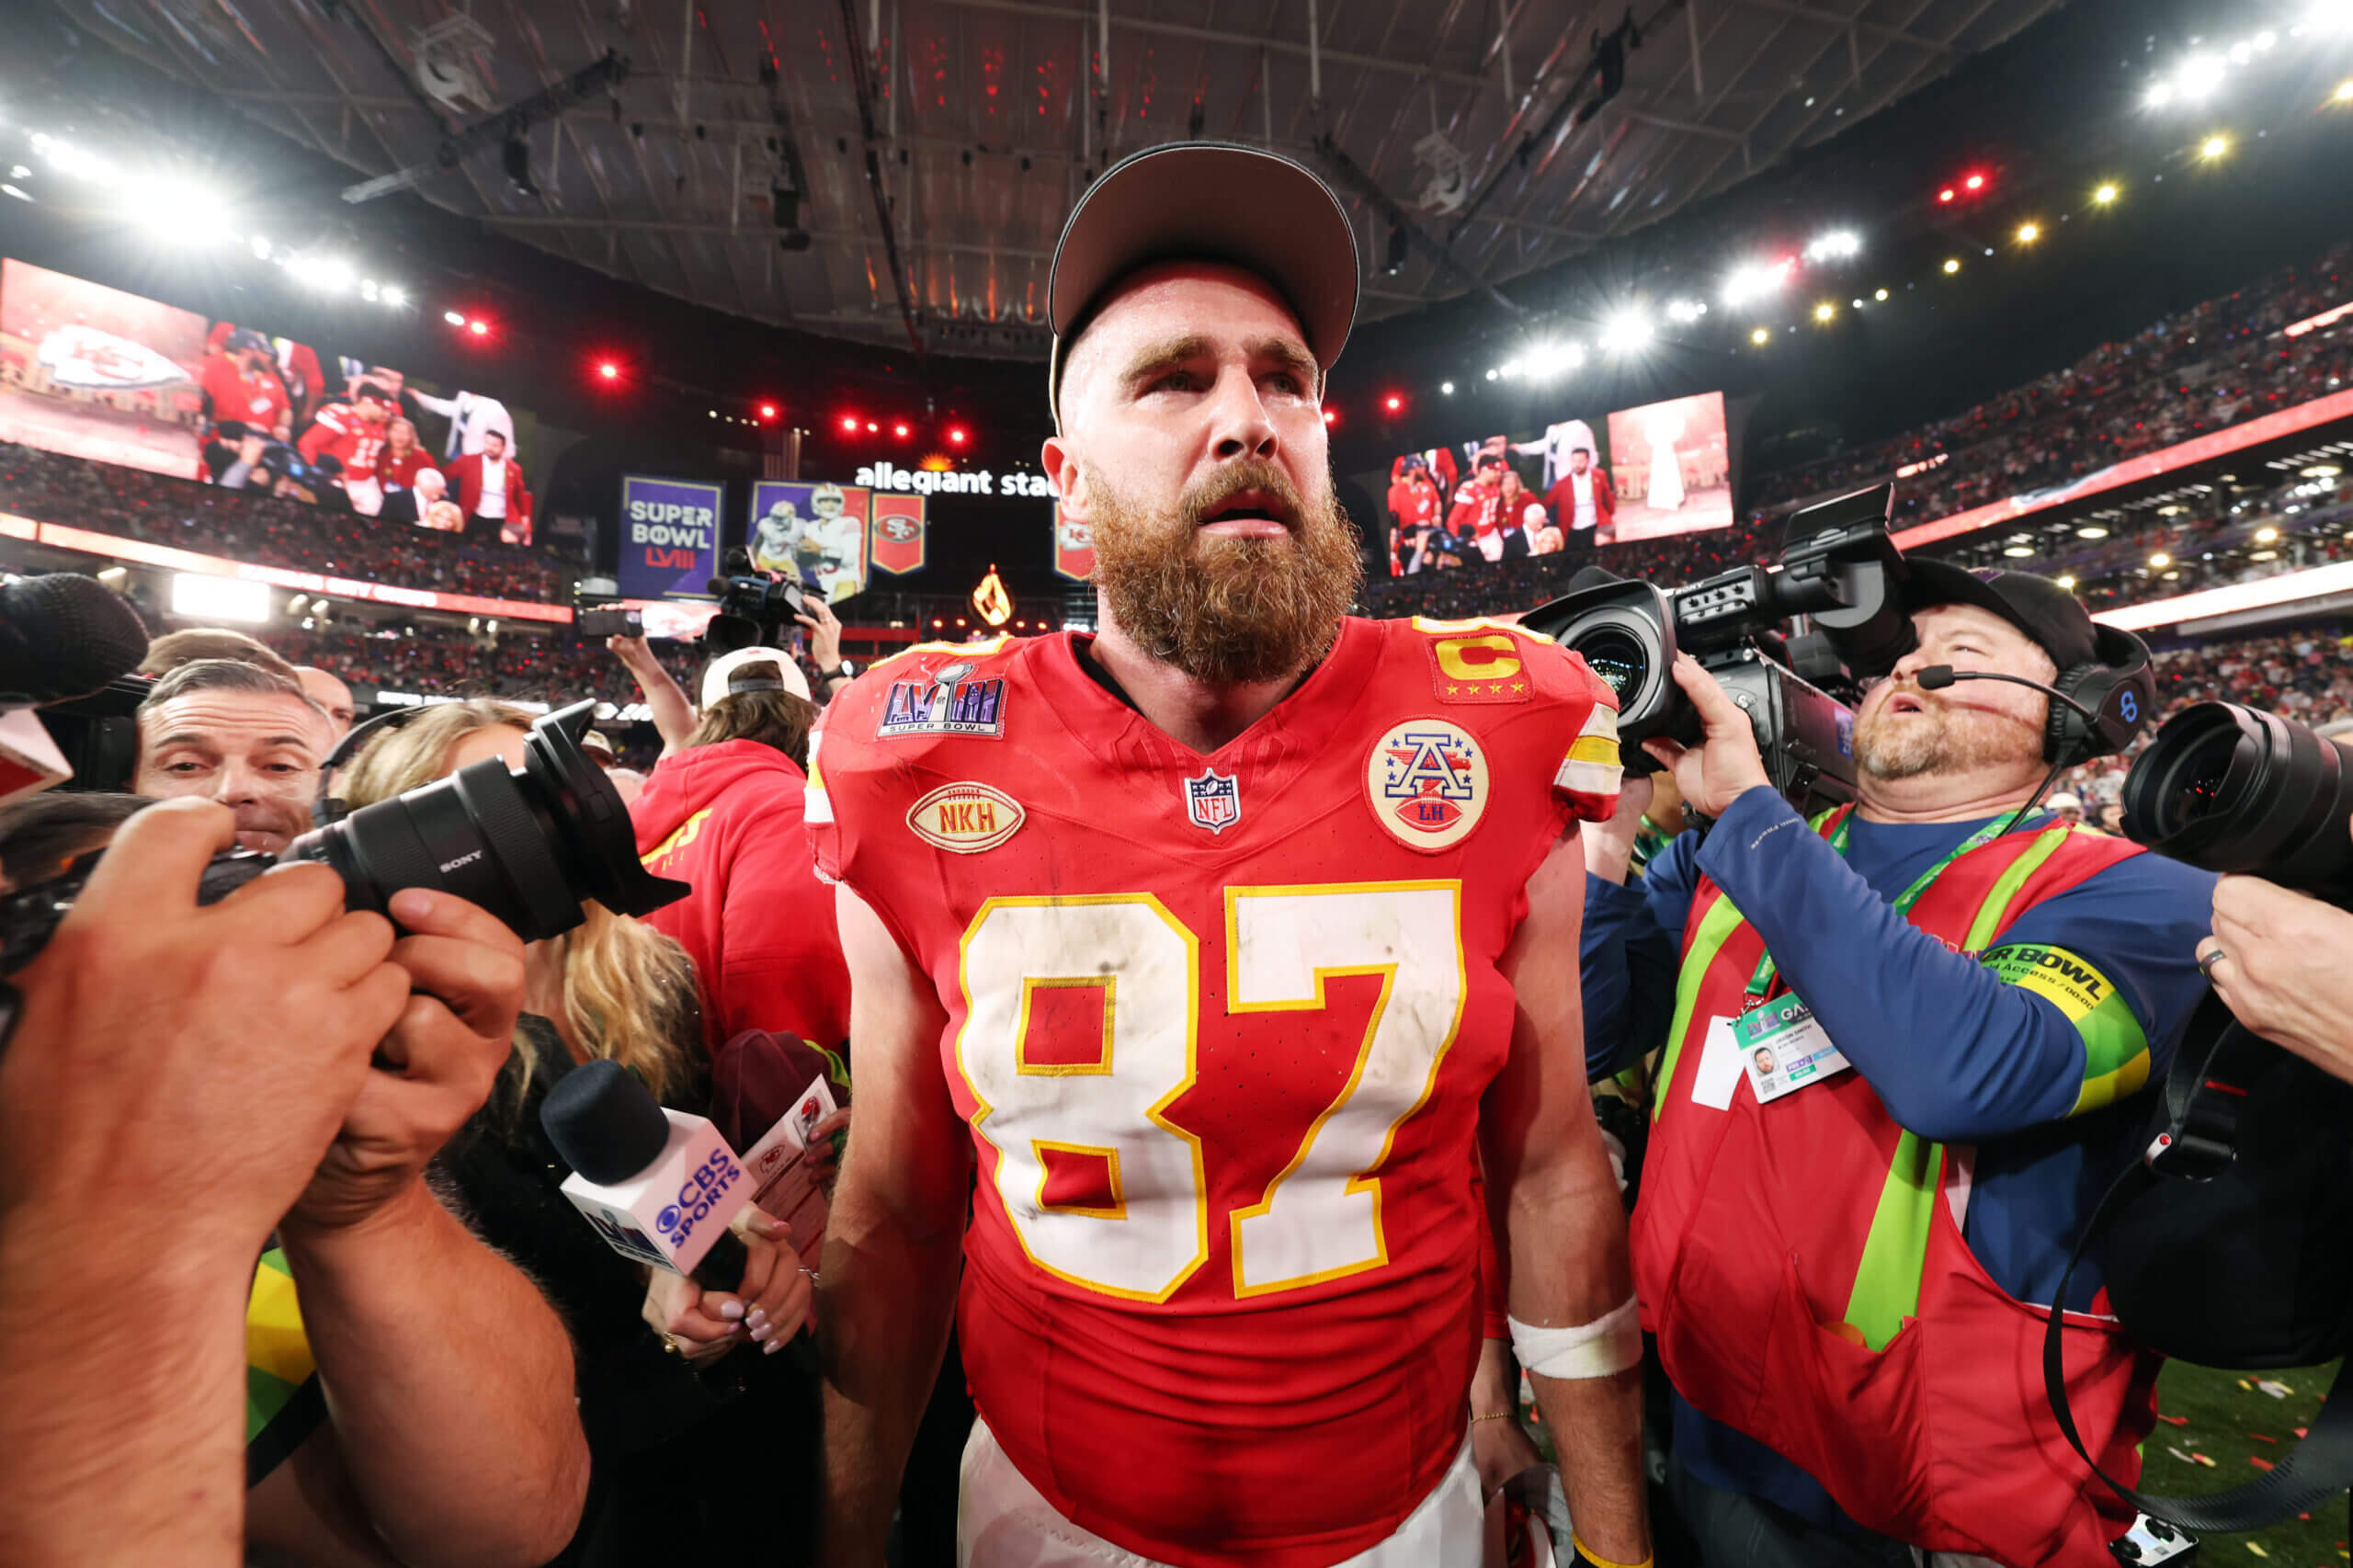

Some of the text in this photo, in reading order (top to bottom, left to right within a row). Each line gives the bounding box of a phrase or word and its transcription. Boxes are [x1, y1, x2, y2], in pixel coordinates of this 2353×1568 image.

[856, 461, 993, 494] allegiant
[630, 499, 712, 528] SUPER
[631, 524, 710, 550] BOWL
[645, 549, 696, 570] LVIII
[1435, 635, 1522, 681] C
[890, 722, 986, 733] SUPER BOWL
[938, 801, 997, 835] NKH
[1196, 797, 1233, 822] NFL
[1418, 803, 1444, 821] LH
[439, 849, 483, 873] SONY
[2000, 962, 2056, 984] Access
[2017, 948, 2102, 1001] BOWL
[1780, 1004, 1809, 1020] GA
[955, 880, 1467, 1304] 87
[678, 1148, 729, 1209] CBS
[670, 1165, 741, 1248] SPORTS
